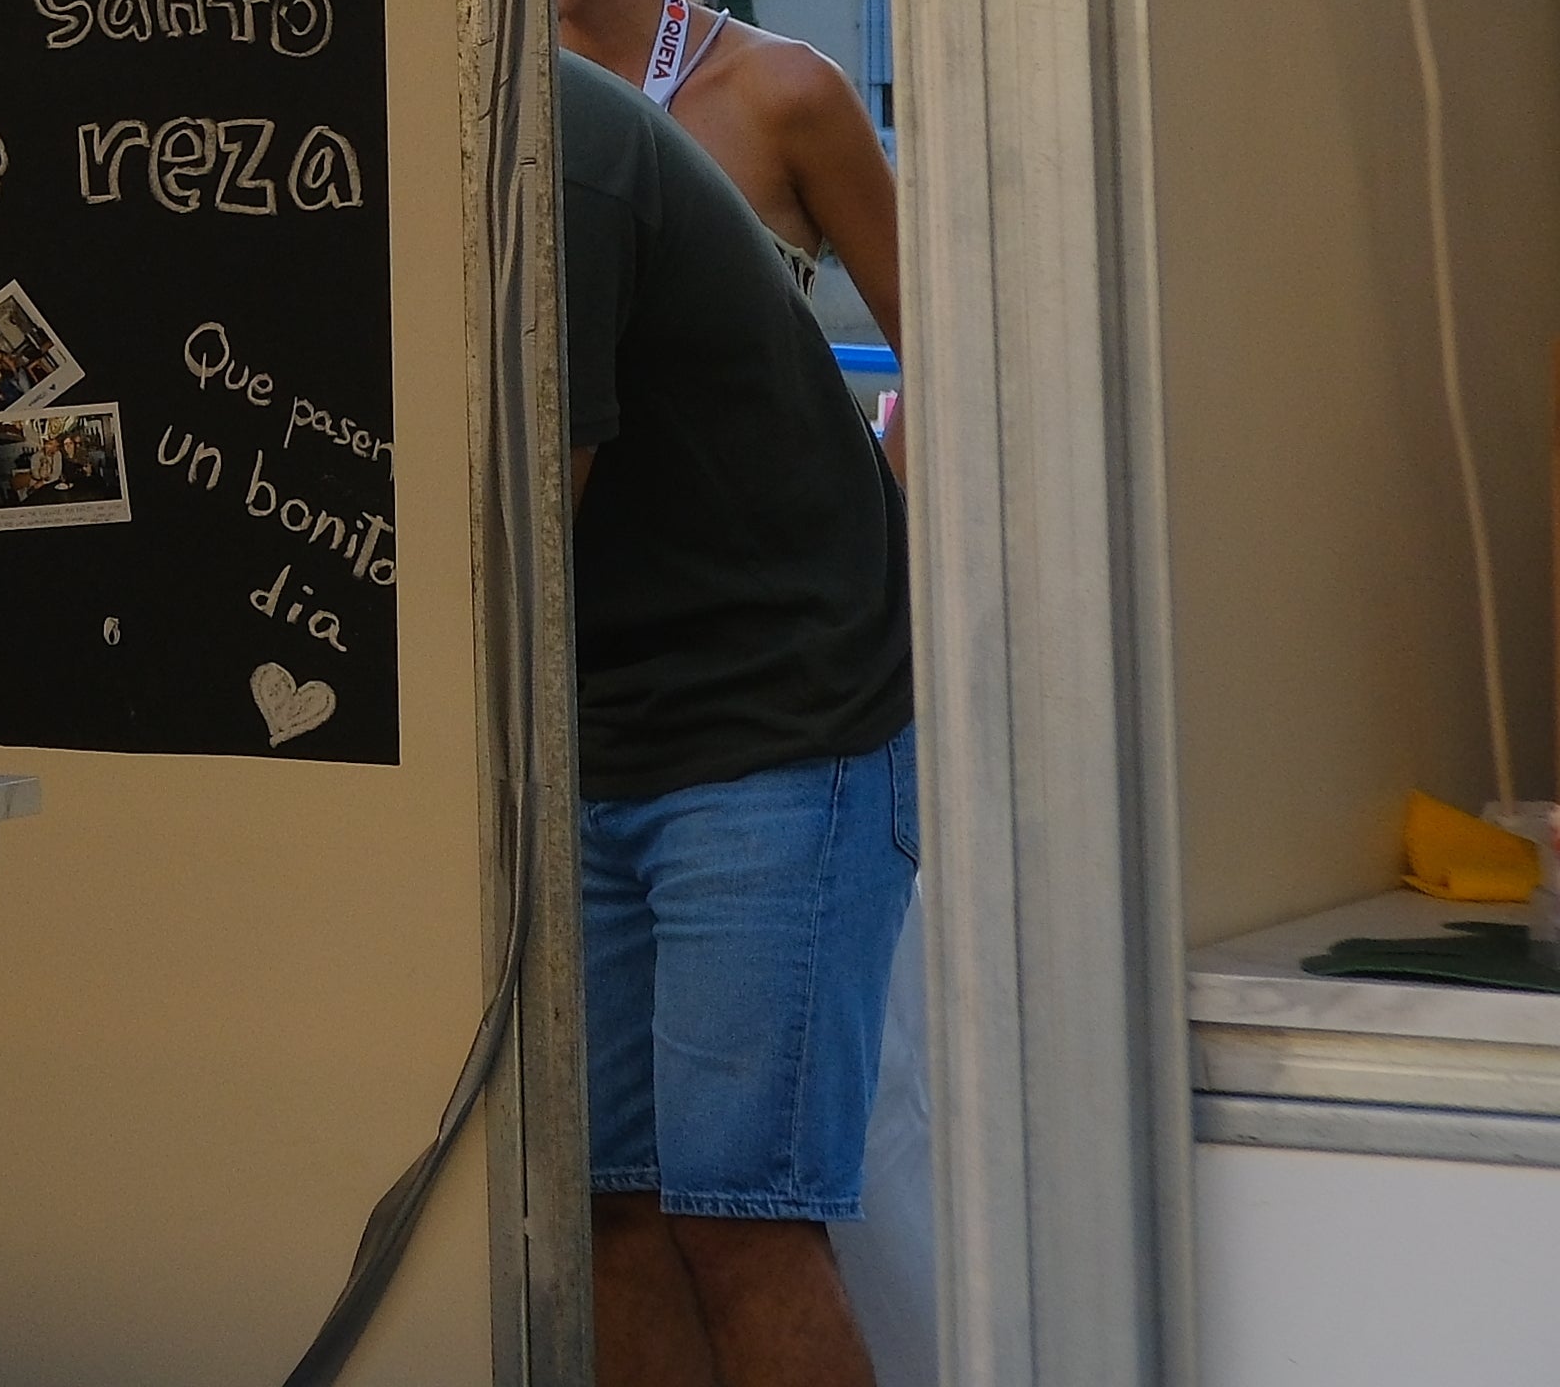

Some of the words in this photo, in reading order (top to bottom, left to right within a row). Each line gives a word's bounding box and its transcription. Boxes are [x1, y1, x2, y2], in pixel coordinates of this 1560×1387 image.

[78, 117, 363, 216] reza
[184, 321, 274, 407] Que
[283, 395, 395, 481] pasen
[157, 424, 222, 491] un
[245, 449, 396, 586] bonito
